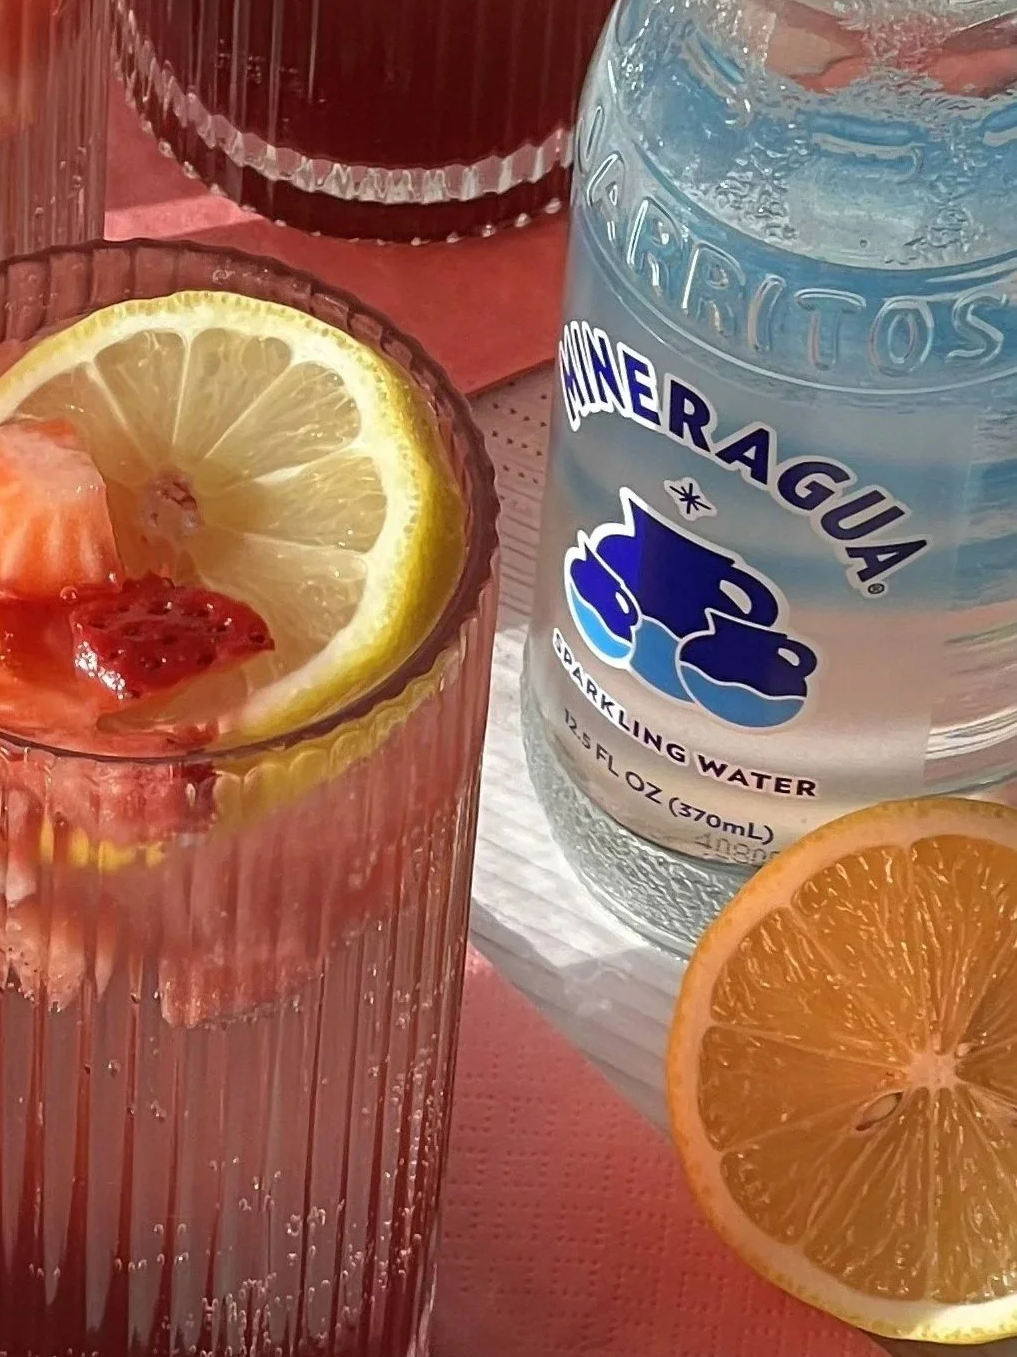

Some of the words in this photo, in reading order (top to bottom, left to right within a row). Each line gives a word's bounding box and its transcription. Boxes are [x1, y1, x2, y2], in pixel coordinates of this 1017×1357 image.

[555, 633, 687, 763] SPARKLING
[697, 754, 817, 797] WATER
[564, 707, 592, 750] 12.5
[595, 743, 620, 778] FL
[625, 771, 663, 805] OZ
[668, 797, 774, 845] (370mL)
